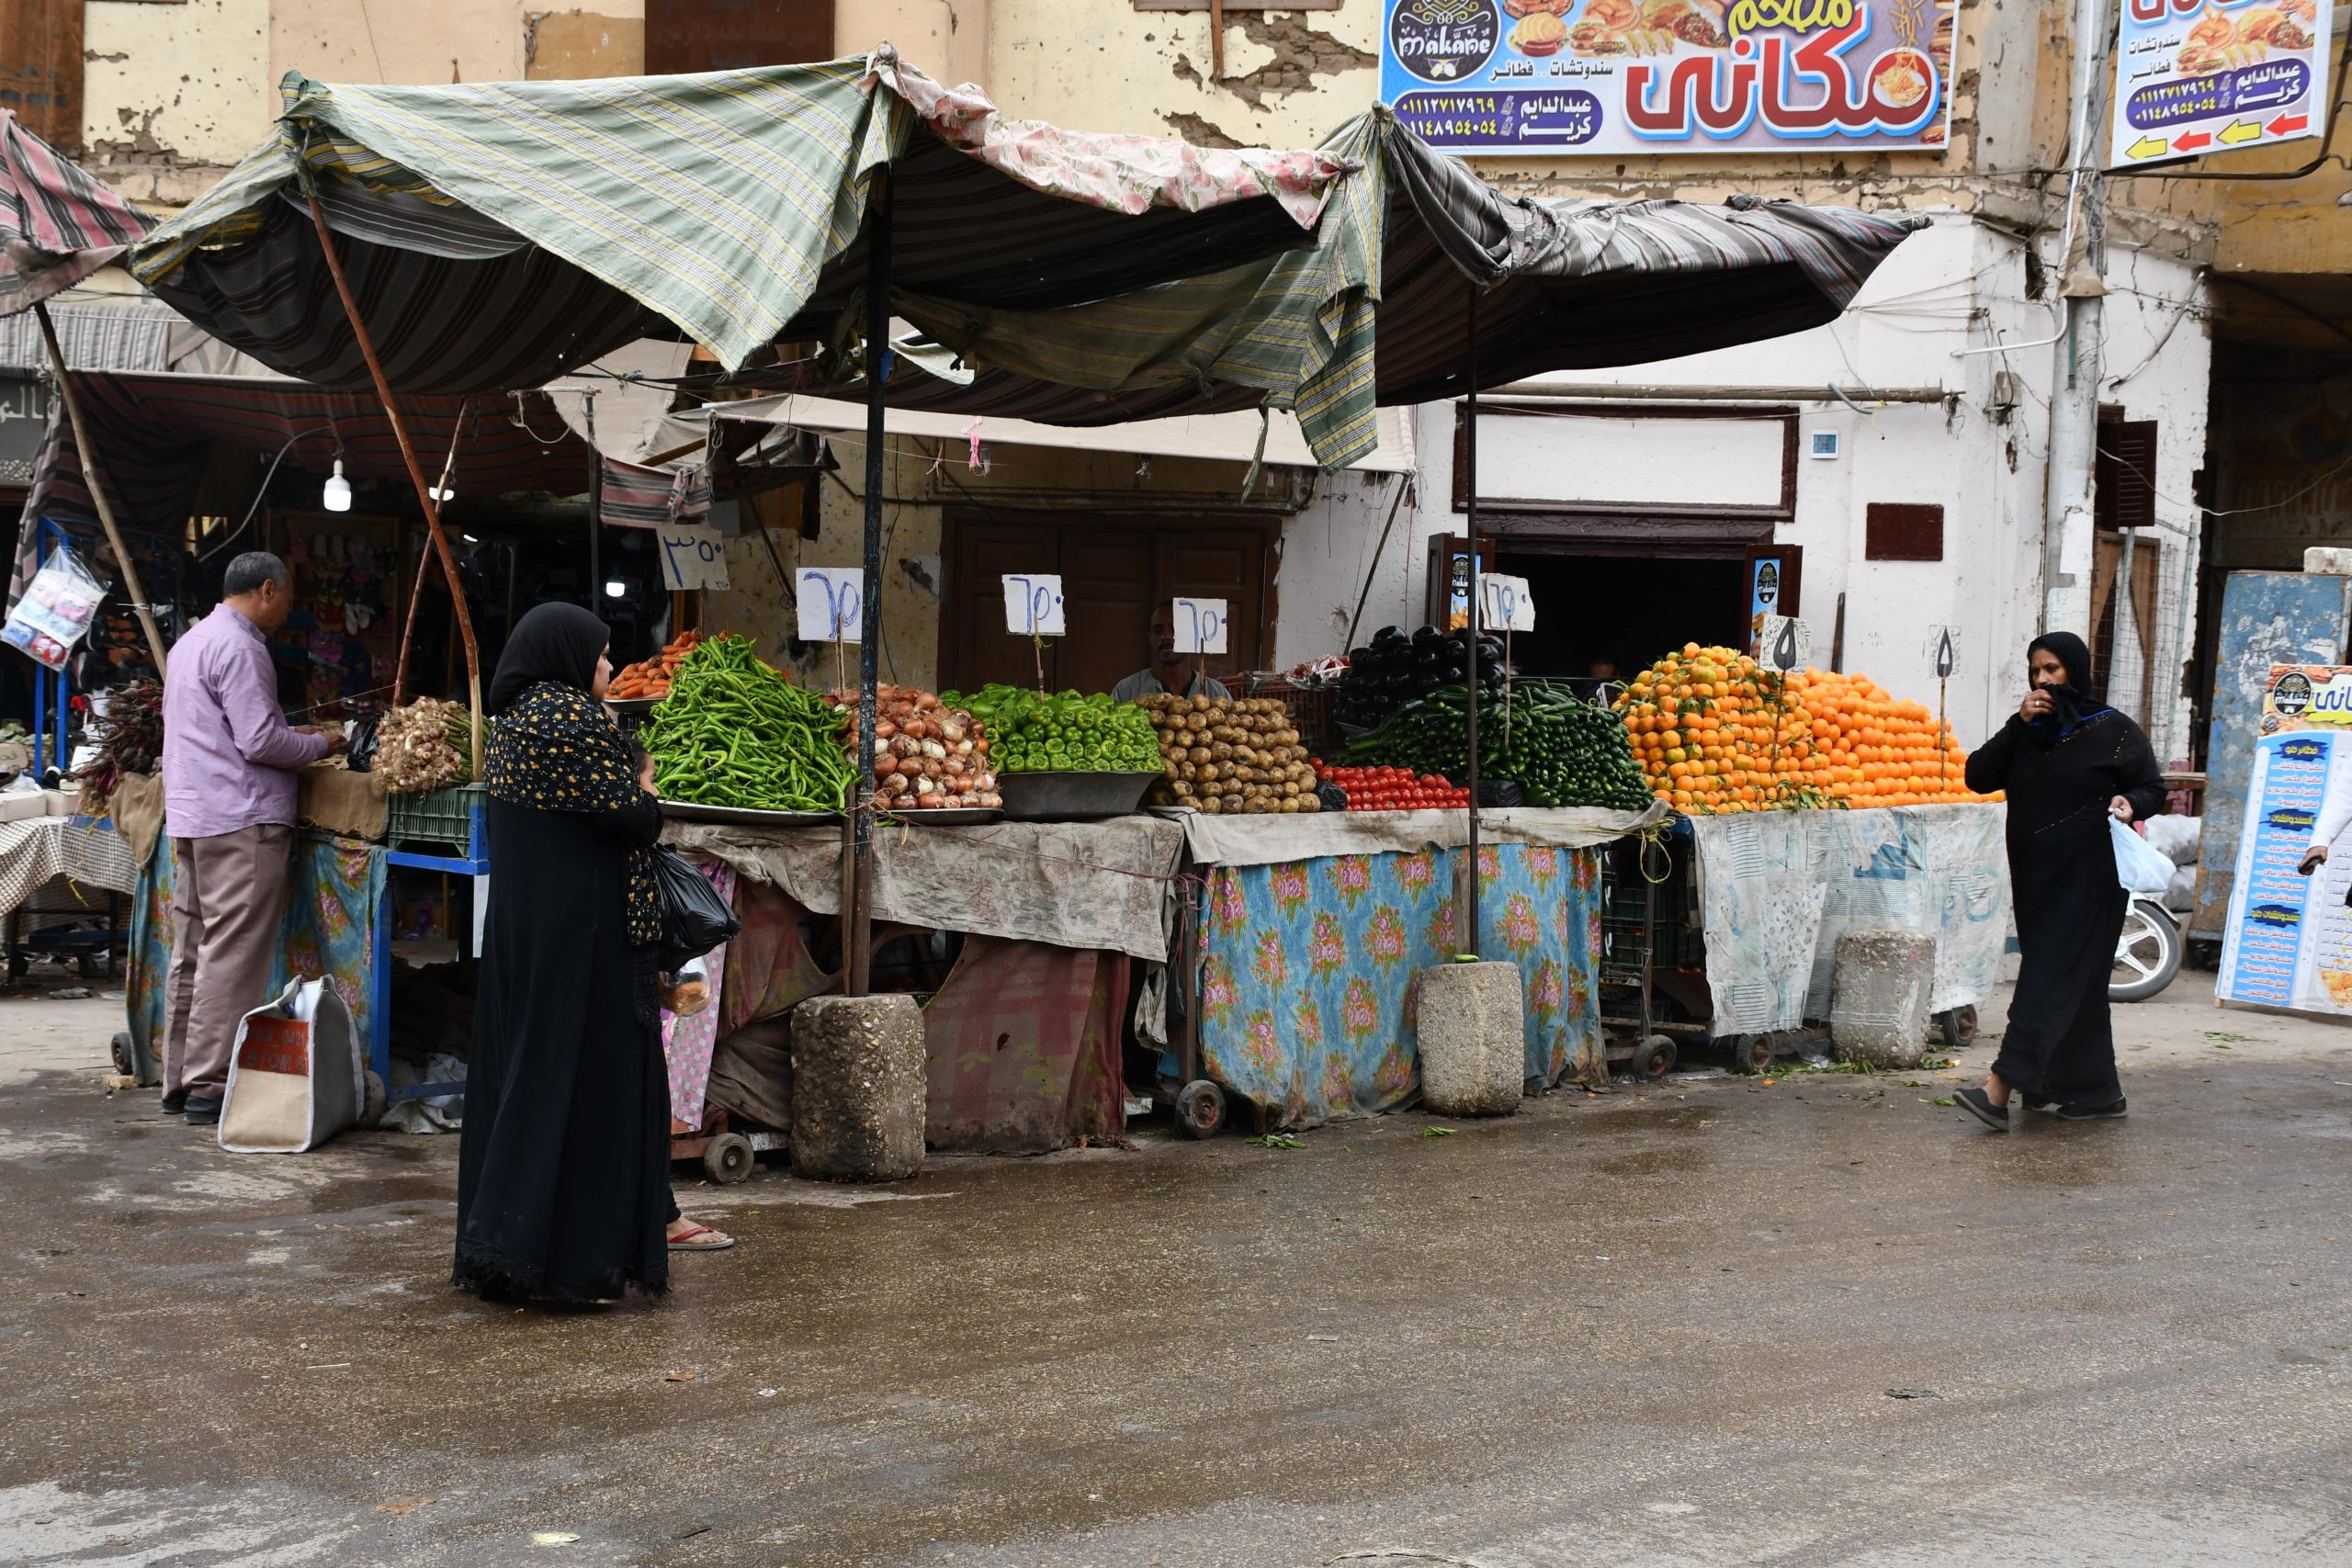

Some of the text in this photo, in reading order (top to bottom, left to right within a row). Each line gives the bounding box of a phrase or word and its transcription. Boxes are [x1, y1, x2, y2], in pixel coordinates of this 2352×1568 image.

[2129, 34, 2181, 54] سندوتشات
[1490, 62, 1533, 81] فطائر
[1550, 60, 1613, 79] سندوتشات
[2128, 59, 2171, 84] فطائر
[2134, 64, 2301, 104] عبدالدايم ٠١١١٢٧١٧٩٦٩
[1402, 96, 1592, 119] عبدالدايم ٠١١١٢٧١٧٩٦٩
[2134, 78, 2301, 120] كريم ٠١١٤٨٩٥٤٠٥٤
[1409, 116, 1592, 141] كريم ١١٤٨٩٥٤٠٥٤
